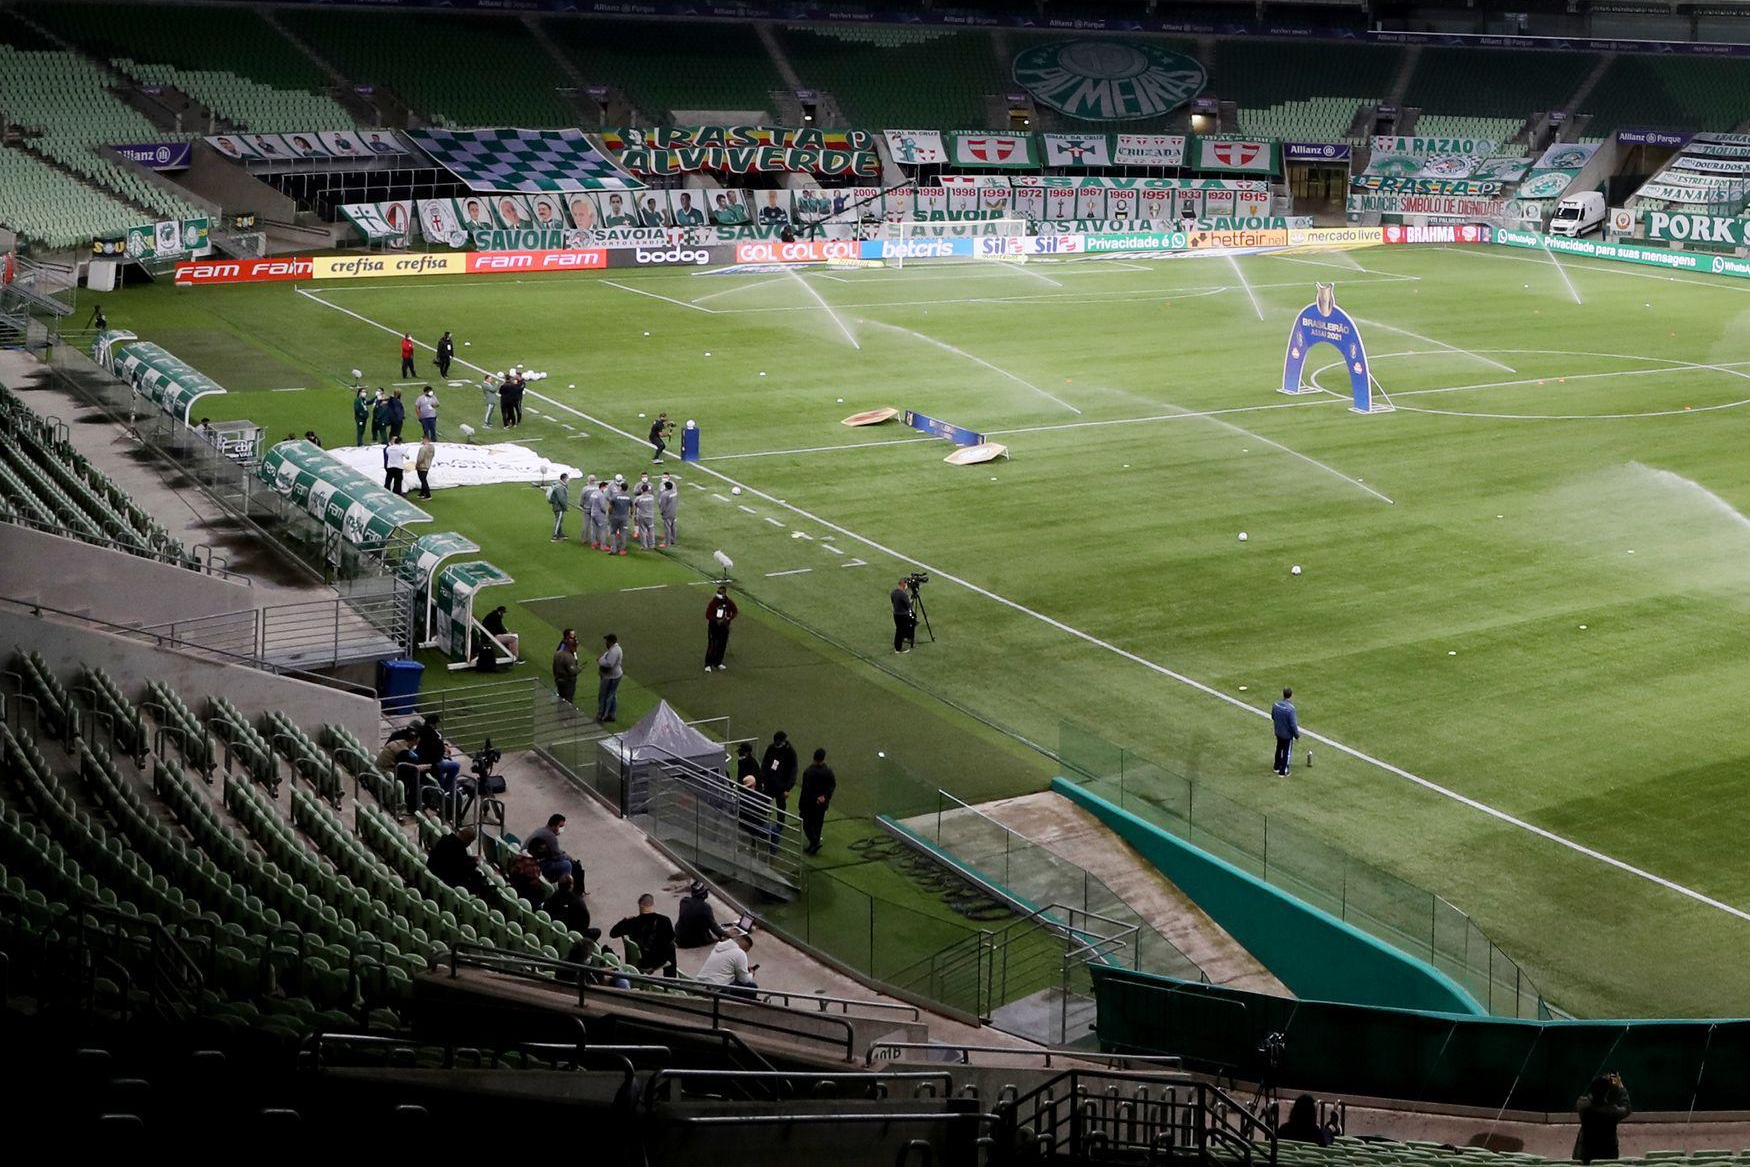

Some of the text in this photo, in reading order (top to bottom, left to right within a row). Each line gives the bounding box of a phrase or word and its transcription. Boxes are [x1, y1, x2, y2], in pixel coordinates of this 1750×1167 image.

[1619, 132, 1681, 144] Allianz Parque
[1118, 147, 1181, 157] CRUZADA
[1291, 145, 1321, 154] Allianz
[620, 148, 881, 176] ALVIVERDE
[854, 188, 877, 197] 2000
[919, 188, 944, 197] 1998
[952, 188, 977, 197] 1998
[983, 189, 1012, 198] 1991
[1018, 189, 1042, 198] 1972
[1049, 189, 1074, 198] 1969
[1080, 188, 1102, 197] 1967
[1109, 190, 1134, 199] 1960
[1142, 190, 1170, 199] 1951
[1178, 191, 1201, 199] 1933
[1208, 192, 1232, 200] 1920
[1239, 192, 1268, 201] 1915
[1362, 196, 1398, 212] MOACIR
[1444, 198, 1455, 213] DE
[1457, 199, 1505, 216] DIGNIDADE
[913, 210, 1005, 222] SAVOIA
[1198, 216, 1287, 231] SAVOIA
[476, 230, 563, 251] SAVOIA
[594, 229, 665, 241] SAVOIA
[1307, 229, 1381, 242] mercado livre
[1407, 226, 1456, 243] BRAHMA
[882, 241, 954, 258] betcris
[1034, 237, 1058, 253] Sil
[1088, 236, 1170, 251] Privacidade é
[636, 248, 710, 264] bodog
[740, 242, 857, 261] GOL GOL GOL
[1508, 233, 1697, 268] WhatsApp Privacidade para suas mensagens
[331, 256, 448, 275] crefisa crefisa
[1327, 331, 1343, 342] 2021
